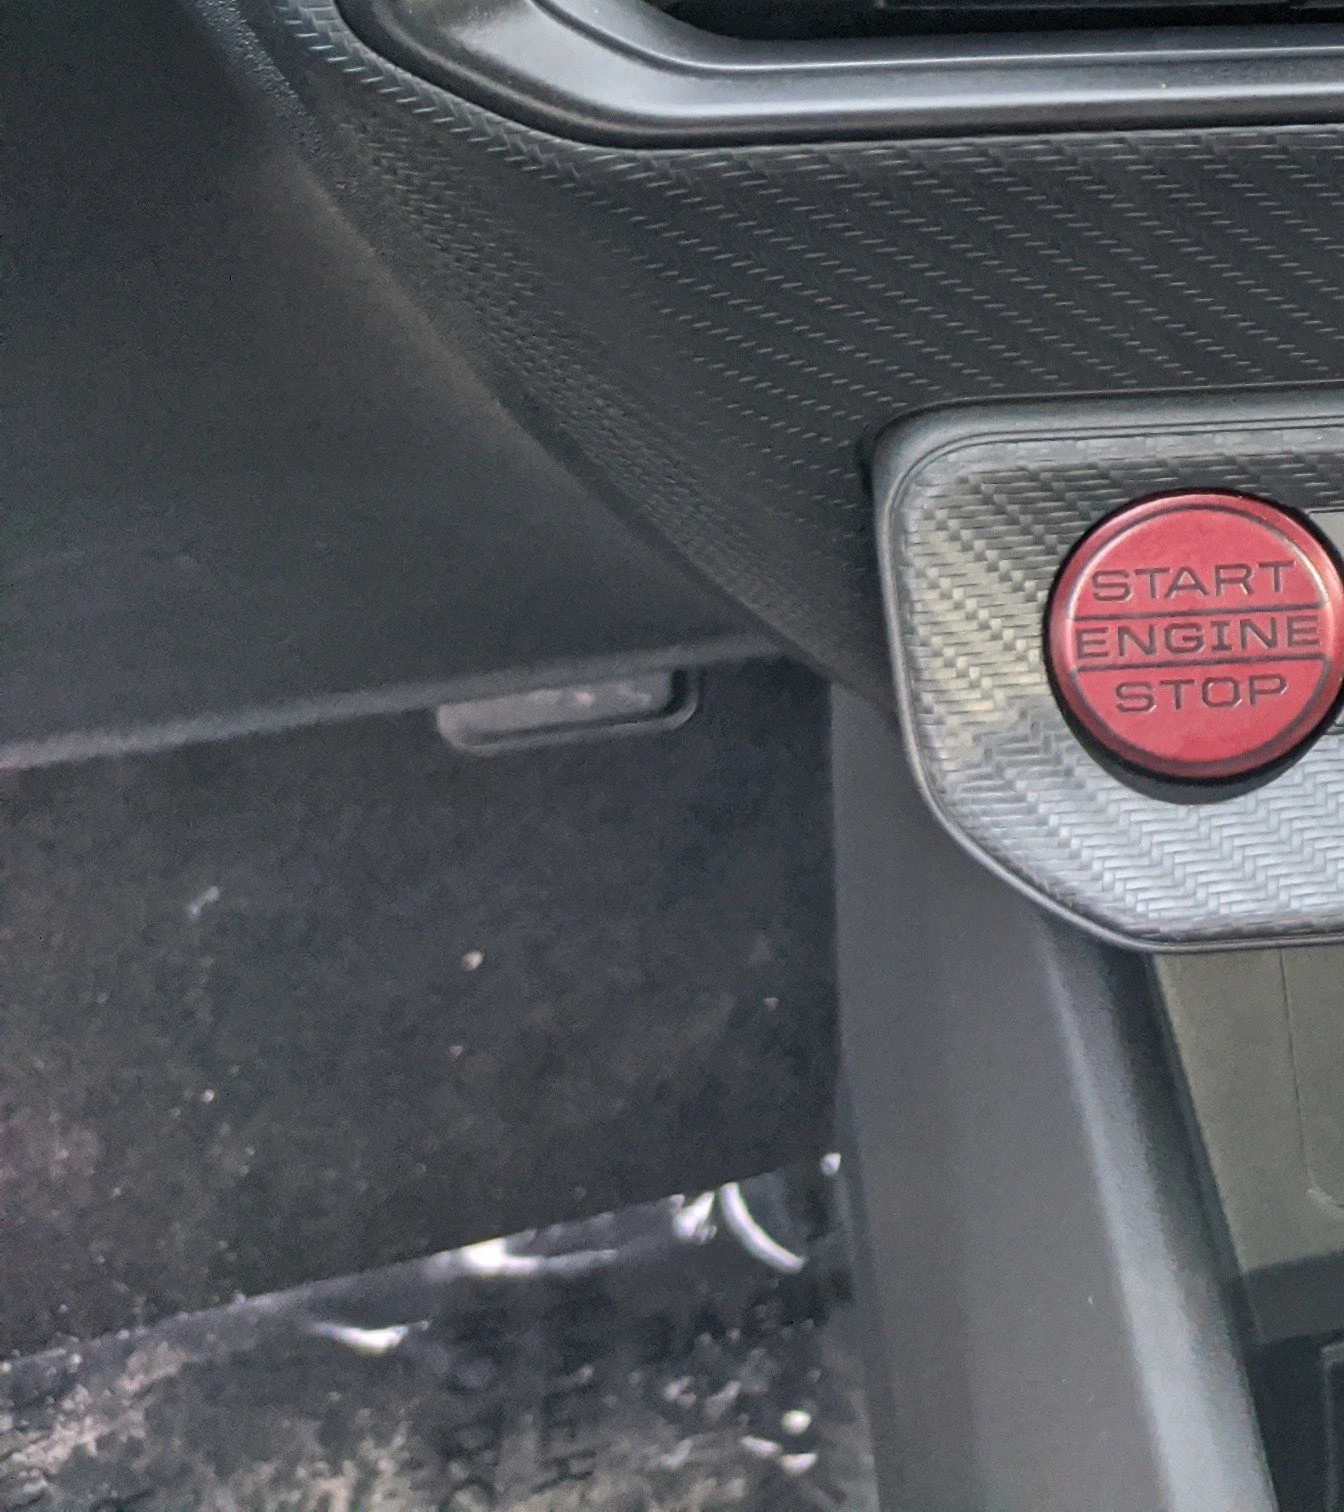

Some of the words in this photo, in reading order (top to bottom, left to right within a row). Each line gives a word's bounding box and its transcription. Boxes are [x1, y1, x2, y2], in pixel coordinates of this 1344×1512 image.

[1091, 559, 1297, 602] START
[1075, 614, 1321, 660] ENGINE
[1114, 674, 1288, 713] STOP
